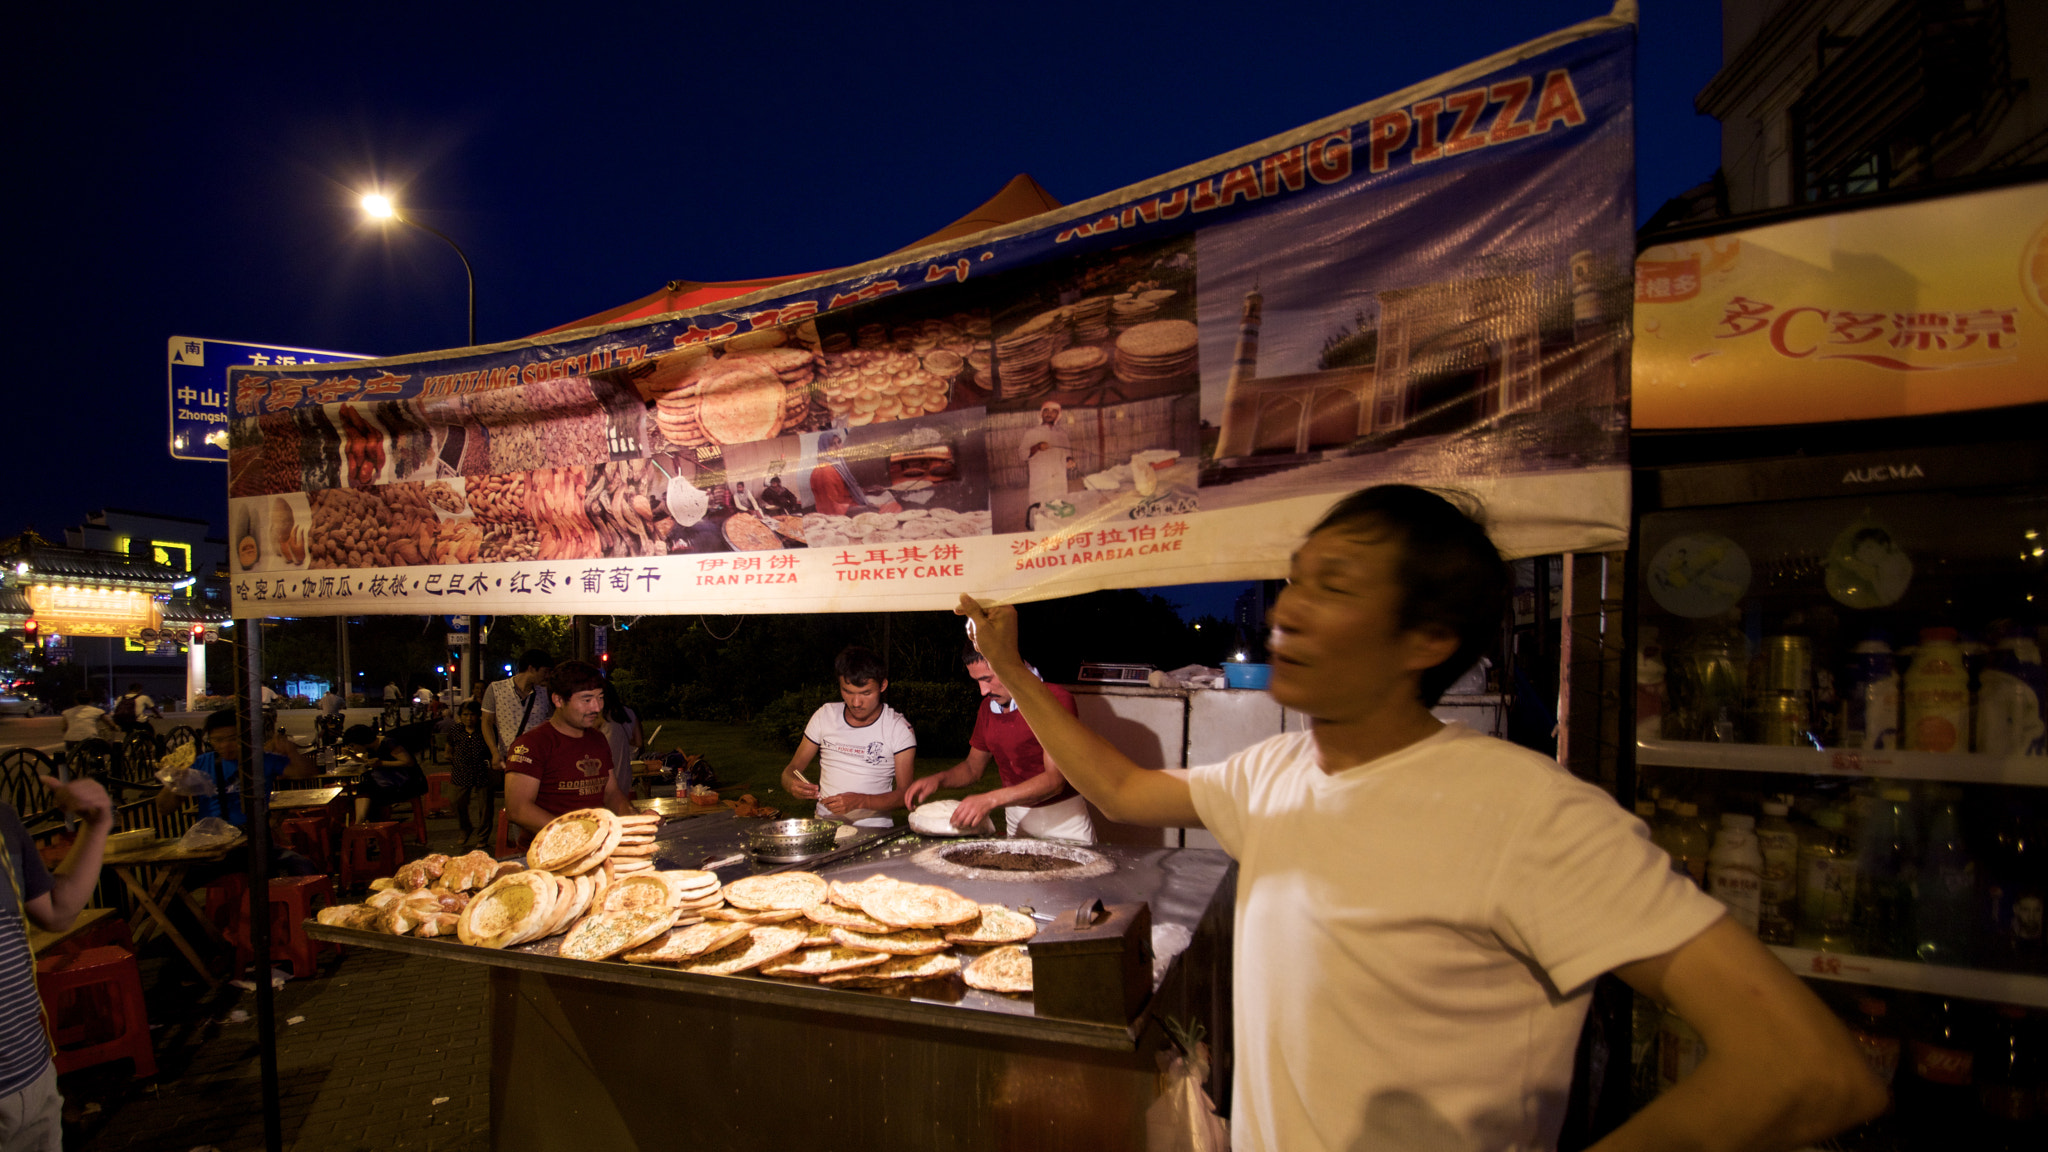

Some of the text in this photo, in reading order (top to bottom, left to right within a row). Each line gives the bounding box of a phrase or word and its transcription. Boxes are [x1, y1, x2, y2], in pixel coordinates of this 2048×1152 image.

[1369, 69, 1586, 173] PIZZA
[185, 341, 200, 354] 南
[177, 386, 228, 407] 中山
[1842, 464, 1925, 483] AUCMA
[1011, 521, 1190, 555] 沙特阿拉伯饼
[696, 554, 801, 572] 伊朗饼
[832, 544, 964, 567] 土耳其饼
[1015, 540, 1183, 571] SAUDI ARABIA CAKE
[696, 572, 798, 586] IRAN PIZZA
[836, 564, 964, 582] TURKEY CAKE
